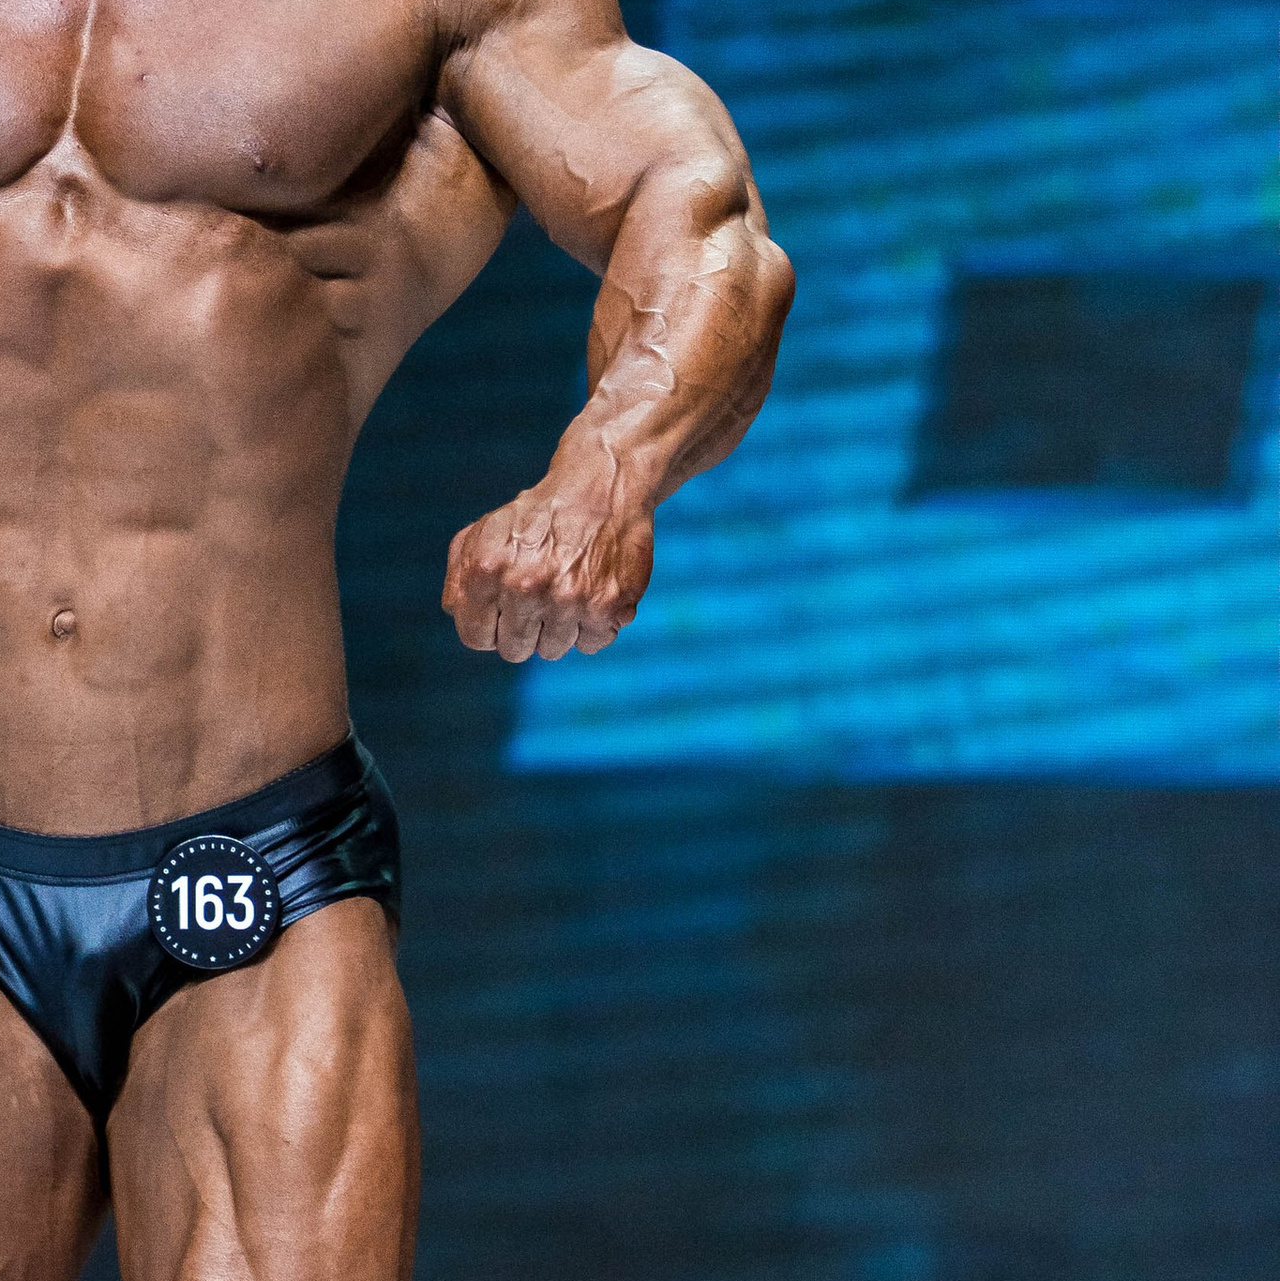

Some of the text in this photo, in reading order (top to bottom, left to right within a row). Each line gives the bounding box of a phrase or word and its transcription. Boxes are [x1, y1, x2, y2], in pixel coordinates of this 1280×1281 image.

[153, 842, 273, 960] NATIONAL BODYBUILDING COMMUNITY
[171, 874, 255, 931] 163
